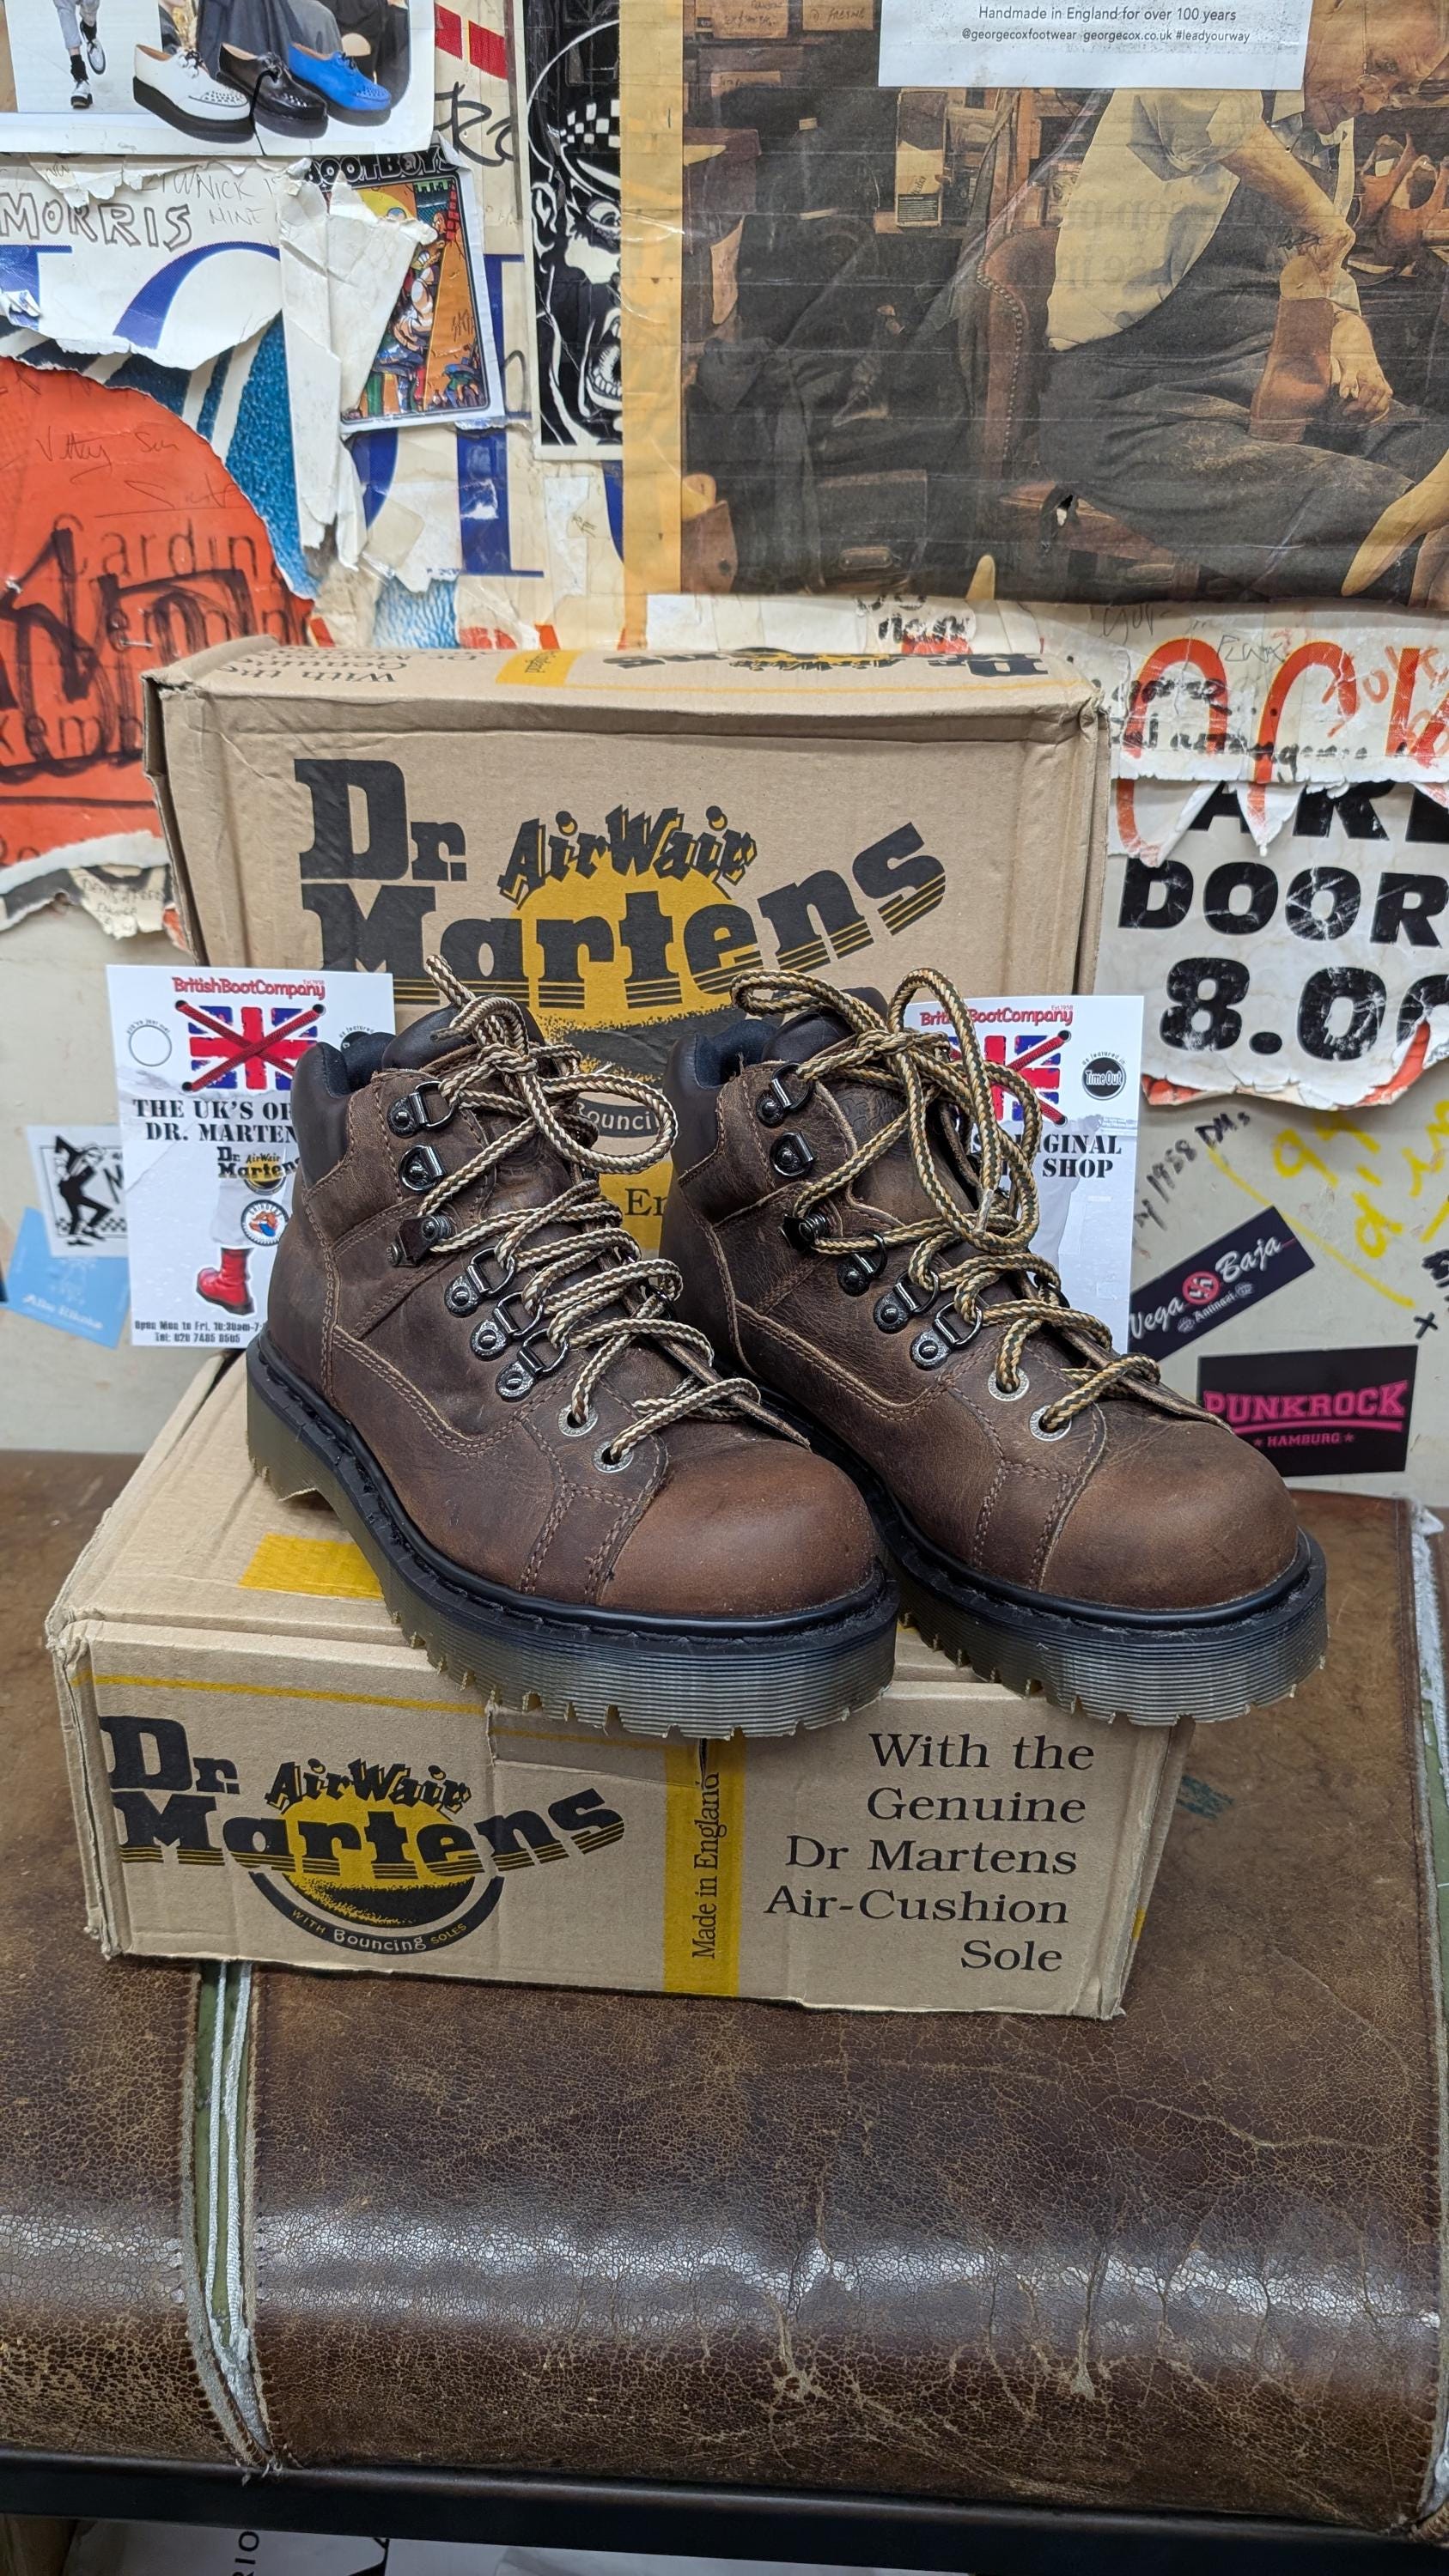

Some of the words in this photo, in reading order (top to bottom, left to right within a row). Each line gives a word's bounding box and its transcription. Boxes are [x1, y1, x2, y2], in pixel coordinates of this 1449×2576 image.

[978, 6, 1047, 21] Handmade
[1050, 6, 1062, 21] in
[1066, 6, 1118, 23] England
[1122, 7, 1140, 21] for
[1143, 9, 1172, 21] over
[1177, 8, 1199, 21] 100
[1202, 10, 1237, 24] years
[961, 27, 1077, 41] @georgecoxfootwear
[1083, 29, 1172, 43] georgecox.co.uk
[1175, 29, 1251, 45] #leadyourway
[294, 759, 467, 881] Dr.
[497, 804, 758, 907] AirWair
[302, 822, 946, 1010] Martens
[172, 976, 326, 1001] BritishBootCompany
[920, 1006, 1074, 1026] BritBootCompany
[133, 1099, 185, 1118] THE
[194, 1100, 253, 1120] UK'S
[146, 1122, 188, 1141] DR.
[1042, 1158, 1114, 1179] SHOP
[1128, 1296, 1184, 1340] Vega
[1215, 1235, 1282, 1285] Baja
[1203, 1380, 1408, 1424] PUNKROCK
[1267, 1432, 1340, 1449] HAMBURG
[100, 1715, 240, 1794] Dr.
[868, 1732, 991, 1770] With
[1012, 1735, 1095, 1771] the
[265, 1758, 472, 1821] AirWair
[867, 1787, 1087, 1824] Genuine
[113, 1789, 625, 1880] Martens
[694, 1771, 728, 1870] England
[785, 1834, 849, 1870] Dr
[868, 1838, 1078, 1875] Martens
[695, 1875, 718, 1898] in
[763, 1885, 1068, 1924] Air-Cushion
[291, 1908, 327, 1935] WITH
[333, 1927, 427, 1953] Bouncing
[430, 1922, 469, 1945] SOLES
[692, 1903, 718, 1959] Made
[960, 1939, 1062, 1972] Sole
